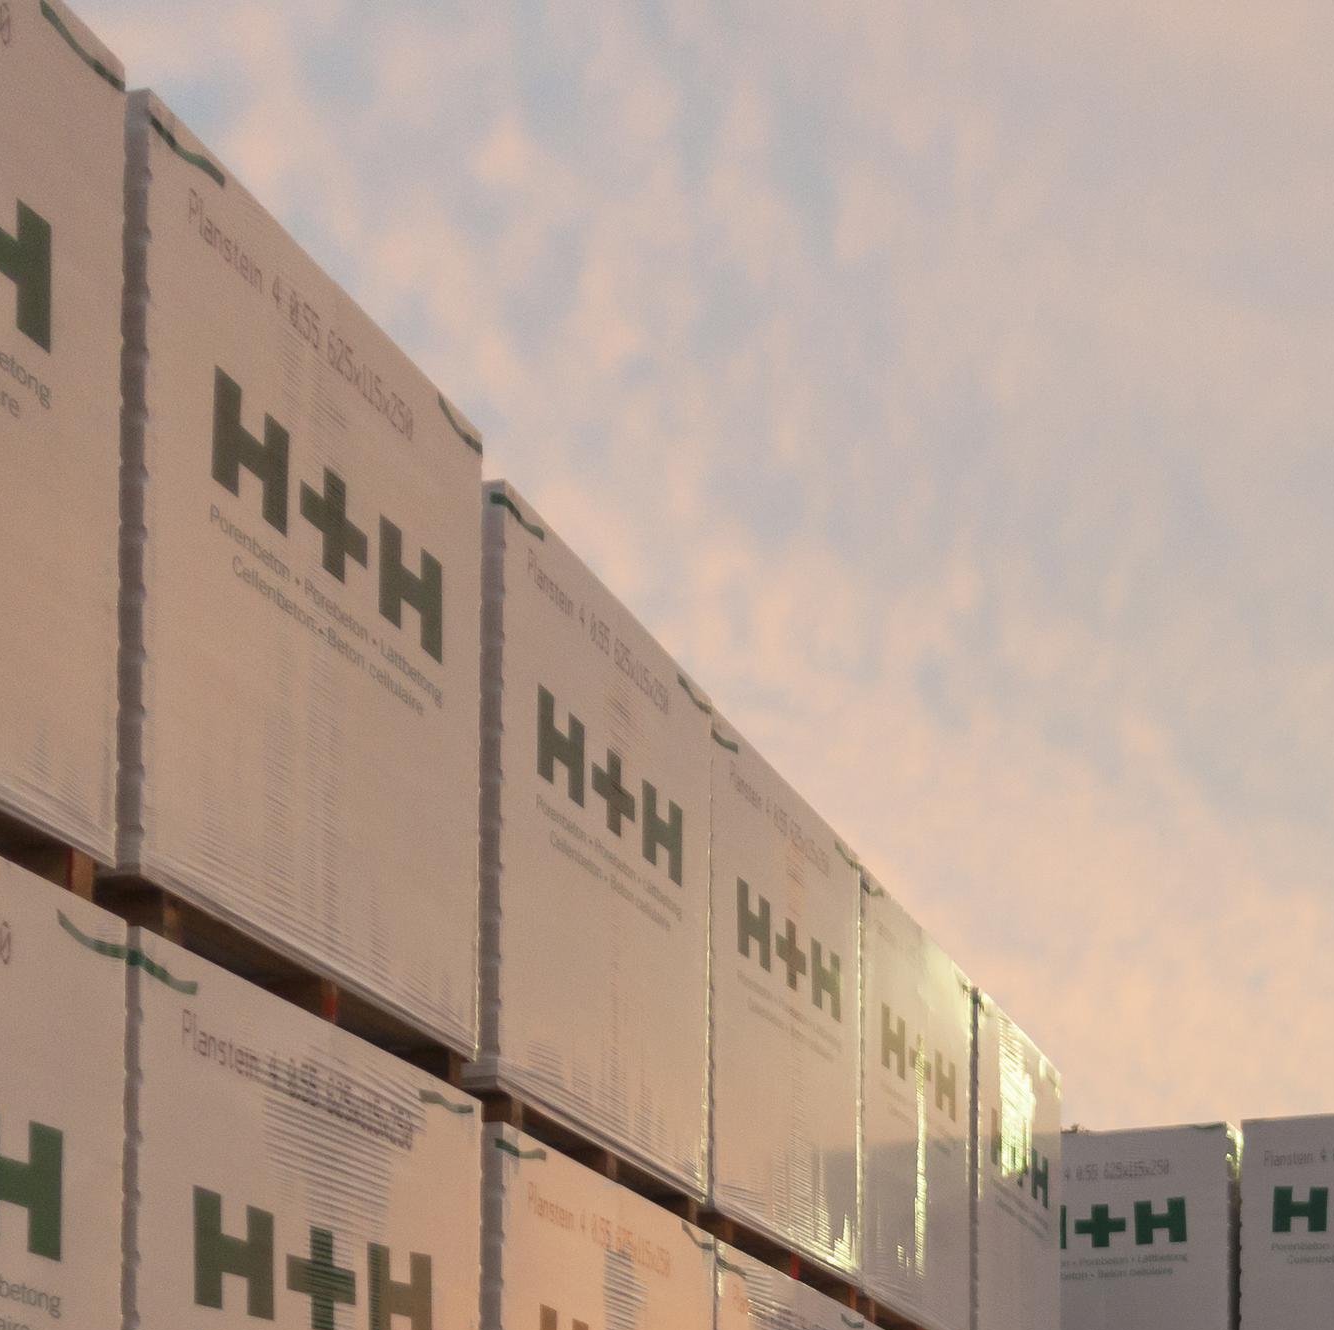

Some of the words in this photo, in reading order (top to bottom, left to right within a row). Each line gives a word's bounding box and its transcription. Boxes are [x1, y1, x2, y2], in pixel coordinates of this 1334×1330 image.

[188, 188, 263, 293] Planstein
[210, 503, 290, 582] Porenbeton
[304, 578, 368, 642] Porebeton
[211, 365, 442, 665] H+H
[232, 555, 316, 633] Cellenbeton
[537, 682, 683, 888] H+H
[737, 876, 841, 1023] H+H
[1060, 1196, 1187, 1250] +H
